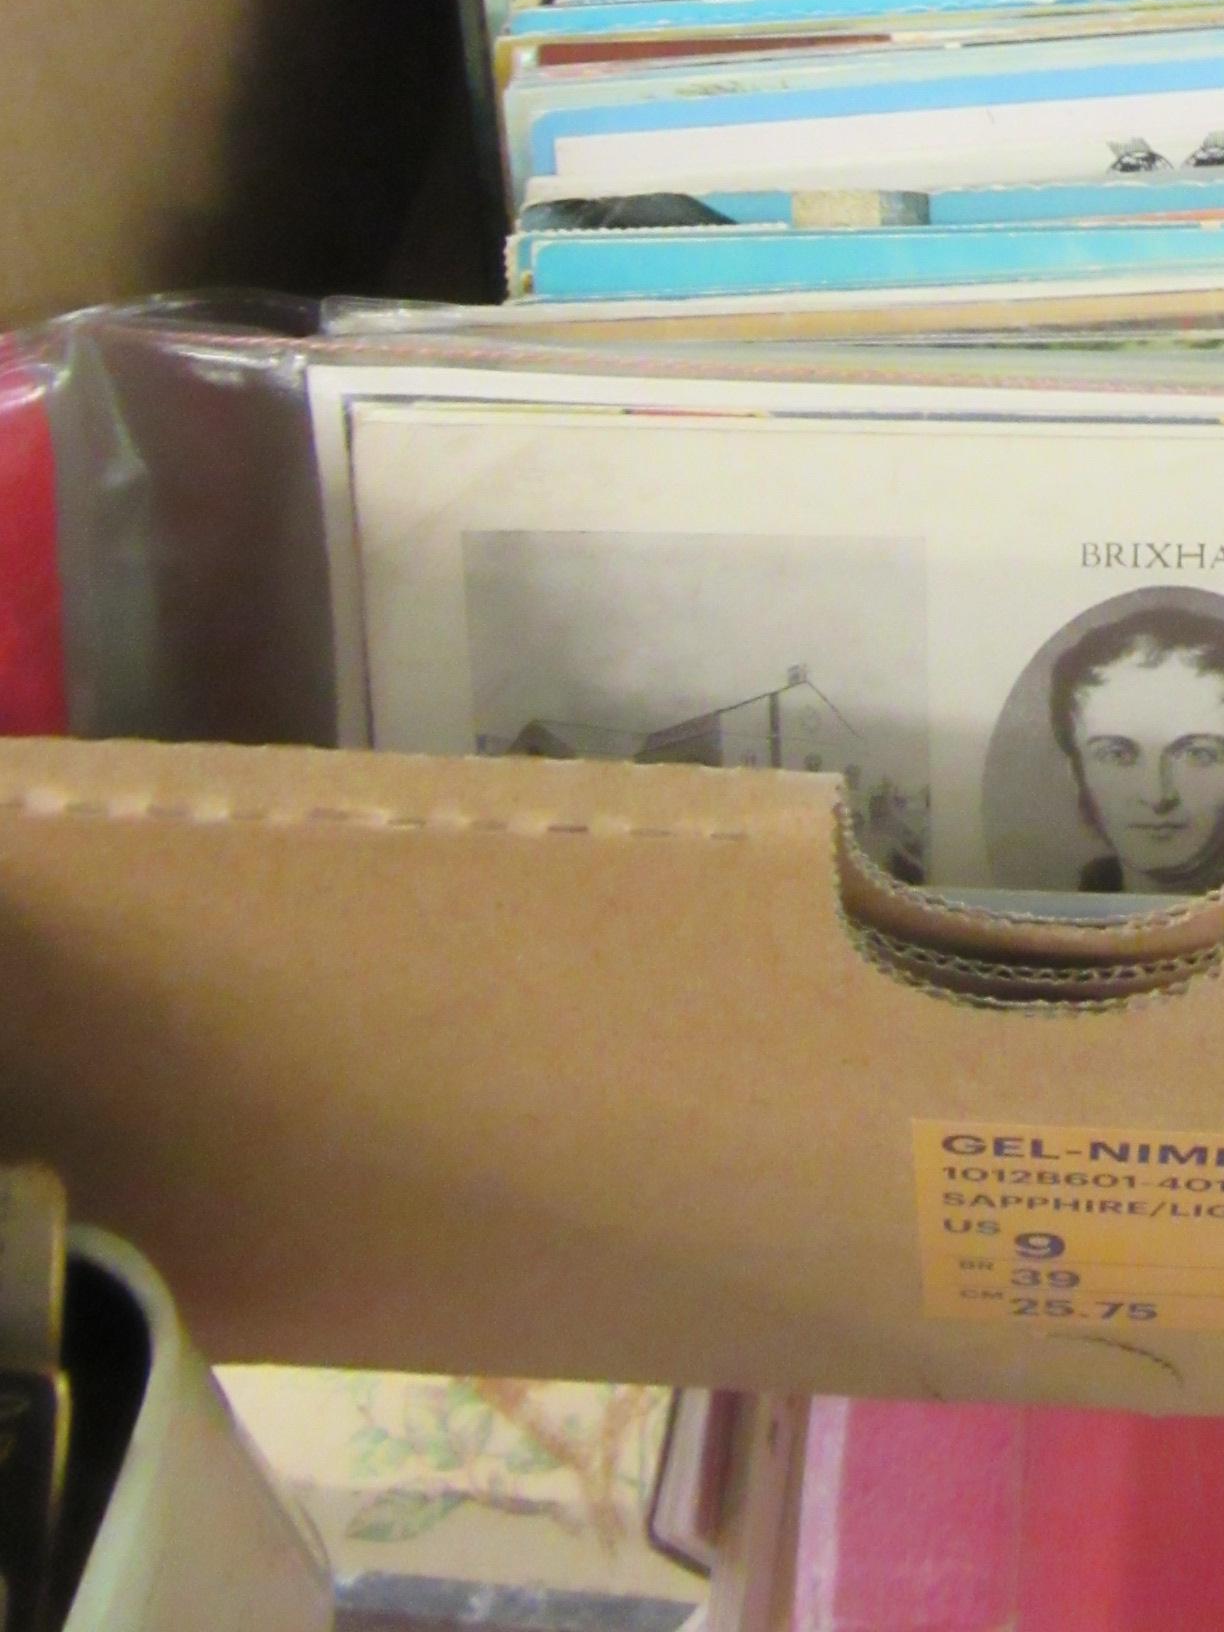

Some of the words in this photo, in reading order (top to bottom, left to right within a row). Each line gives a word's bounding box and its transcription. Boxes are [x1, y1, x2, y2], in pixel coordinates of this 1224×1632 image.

[943, 1219, 1001, 1235] US
[1014, 1232, 1066, 1260] 9
[1009, 1268, 1081, 1290] 39
[1009, 1298, 1158, 1320] 25.75
